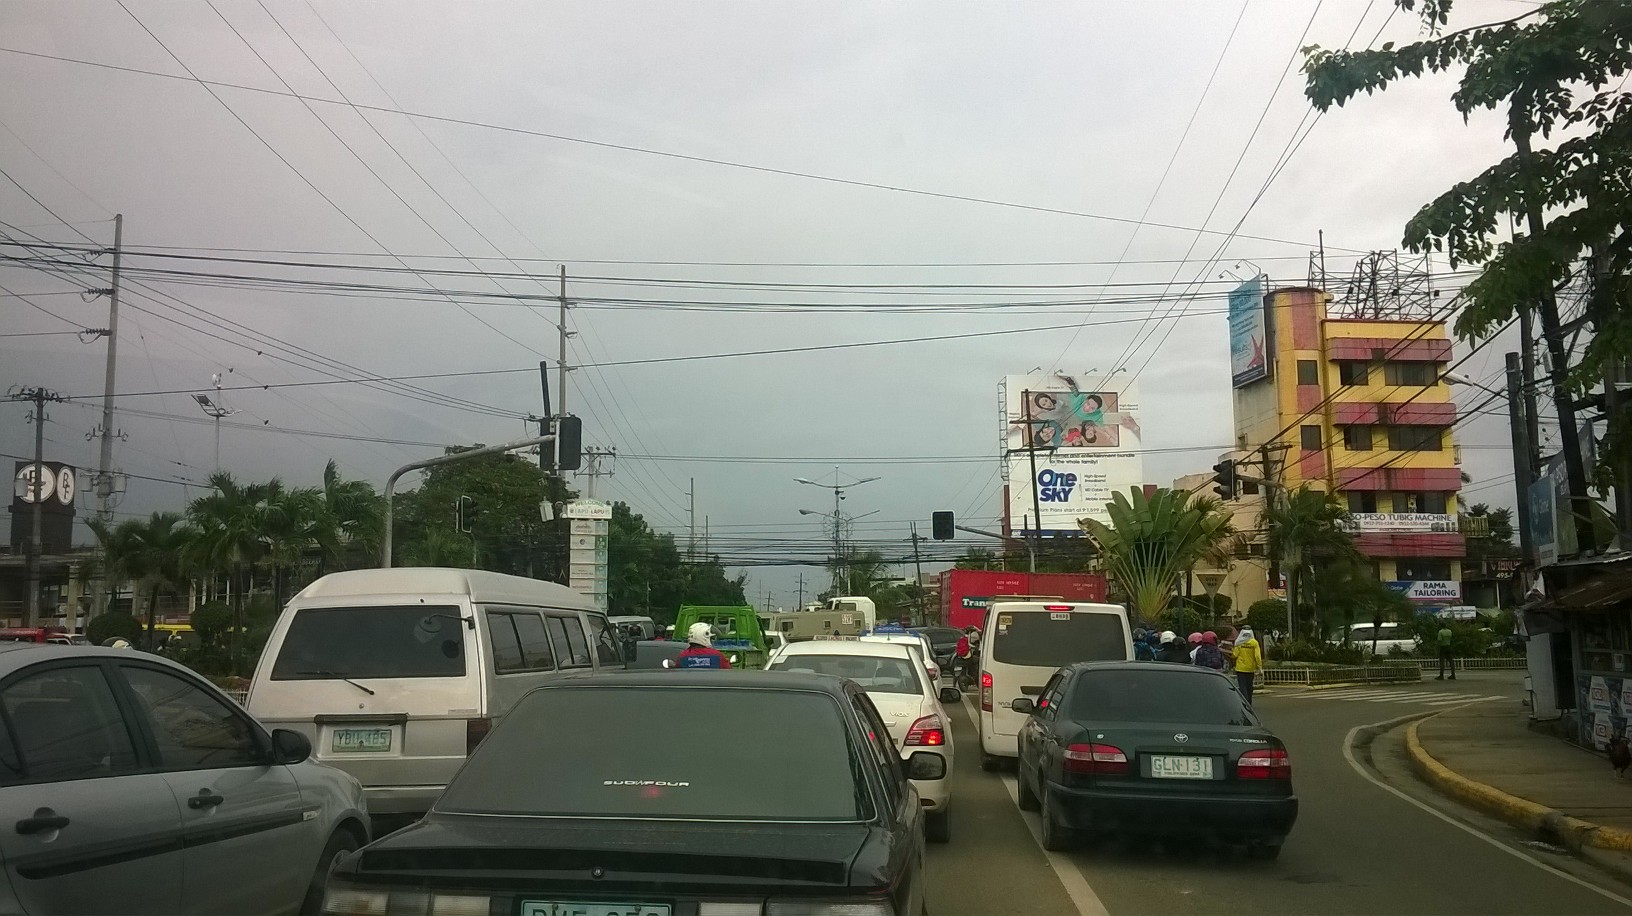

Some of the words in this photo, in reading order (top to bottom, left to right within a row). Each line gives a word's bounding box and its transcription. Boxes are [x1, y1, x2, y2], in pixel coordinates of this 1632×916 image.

[1038, 469, 1077, 487] One
[1039, 488, 1073, 502] SKY
[1388, 514, 1413, 522] TUBIG
[1415, 514, 1452, 522] MACHINE
[1414, 589, 1457, 597] TAILORING
